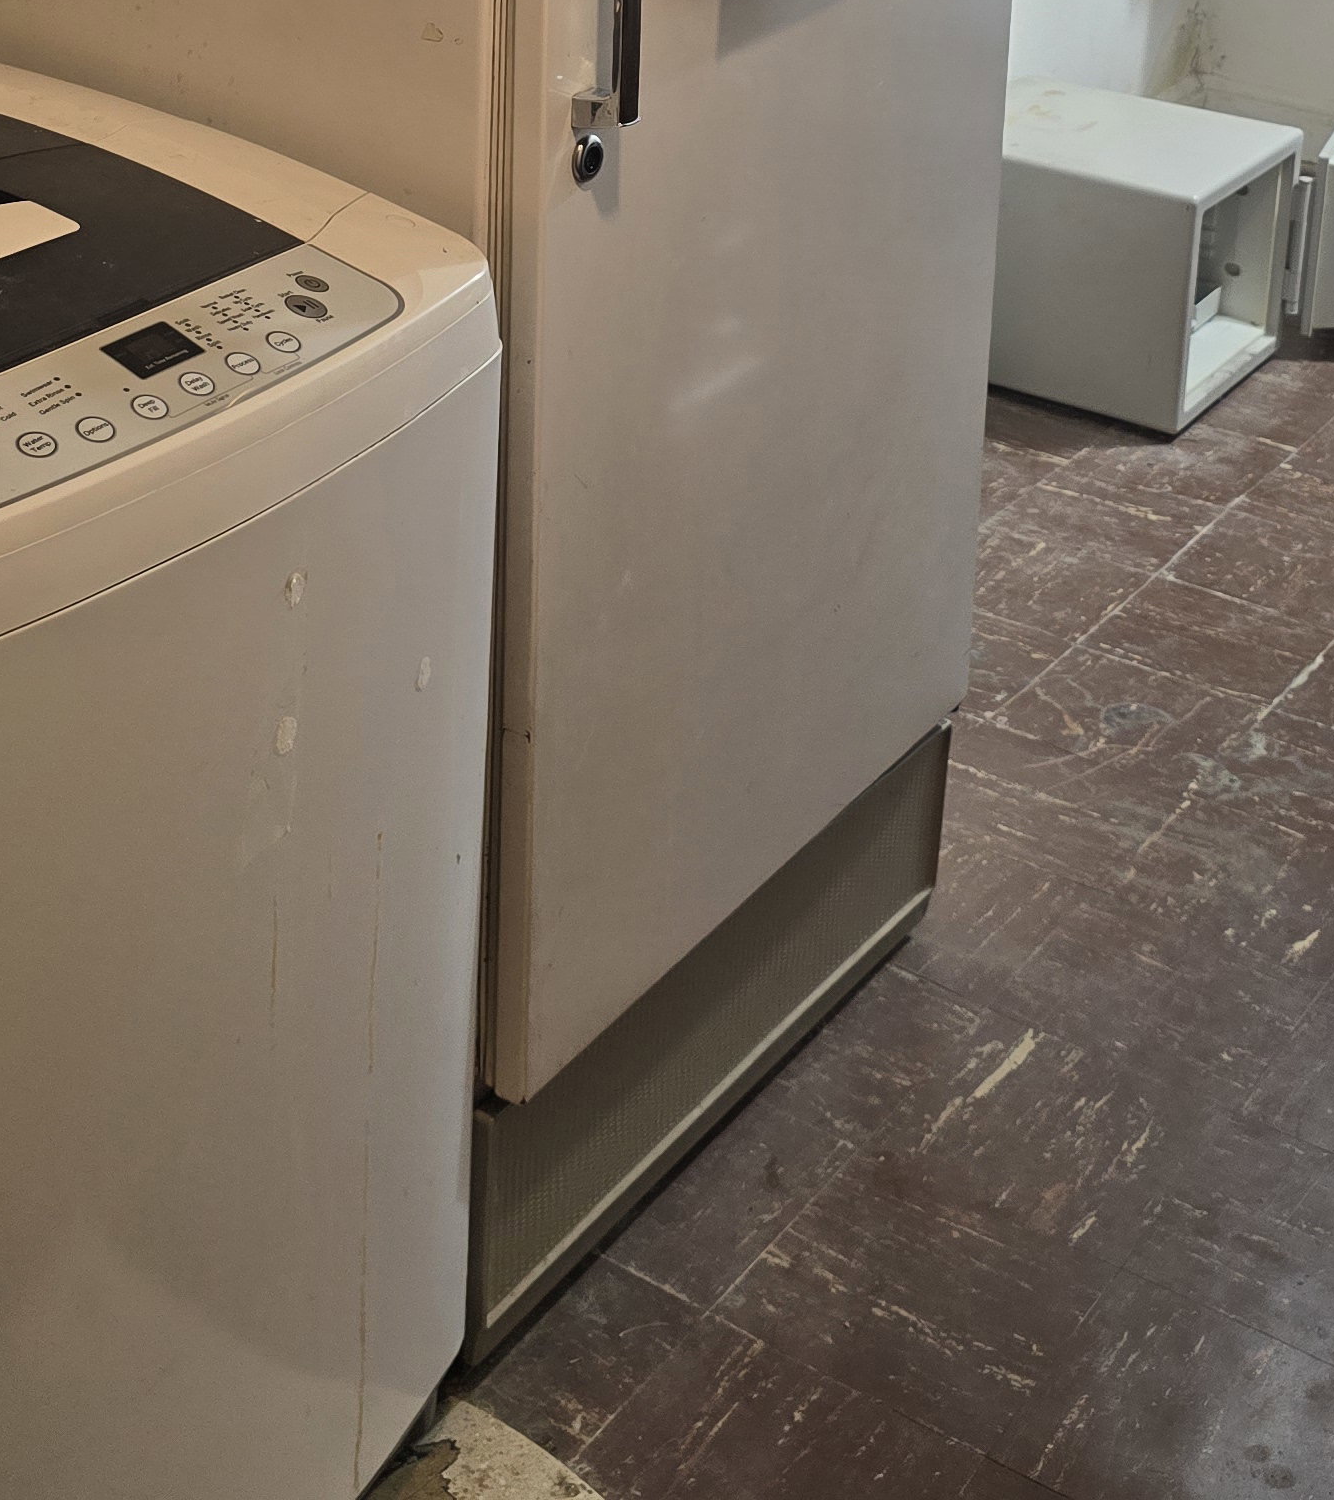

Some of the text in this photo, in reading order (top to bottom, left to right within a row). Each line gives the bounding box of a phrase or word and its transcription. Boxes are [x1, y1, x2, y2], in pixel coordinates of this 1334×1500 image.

[231, 357, 255, 370] Process
[184, 375, 204, 387] Delay
[191, 381, 210, 393] Wash
[28, 396, 48, 408] Extra
[38, 394, 76, 415] Gentle Spin
[137, 399, 156, 410] Deep
[148, 405, 160, 413] Fill
[0, 411, 17, 422] Cold
[82, 421, 111, 438] Options
[22, 435, 44, 448] Water
[30, 441, 52, 453] Temp
